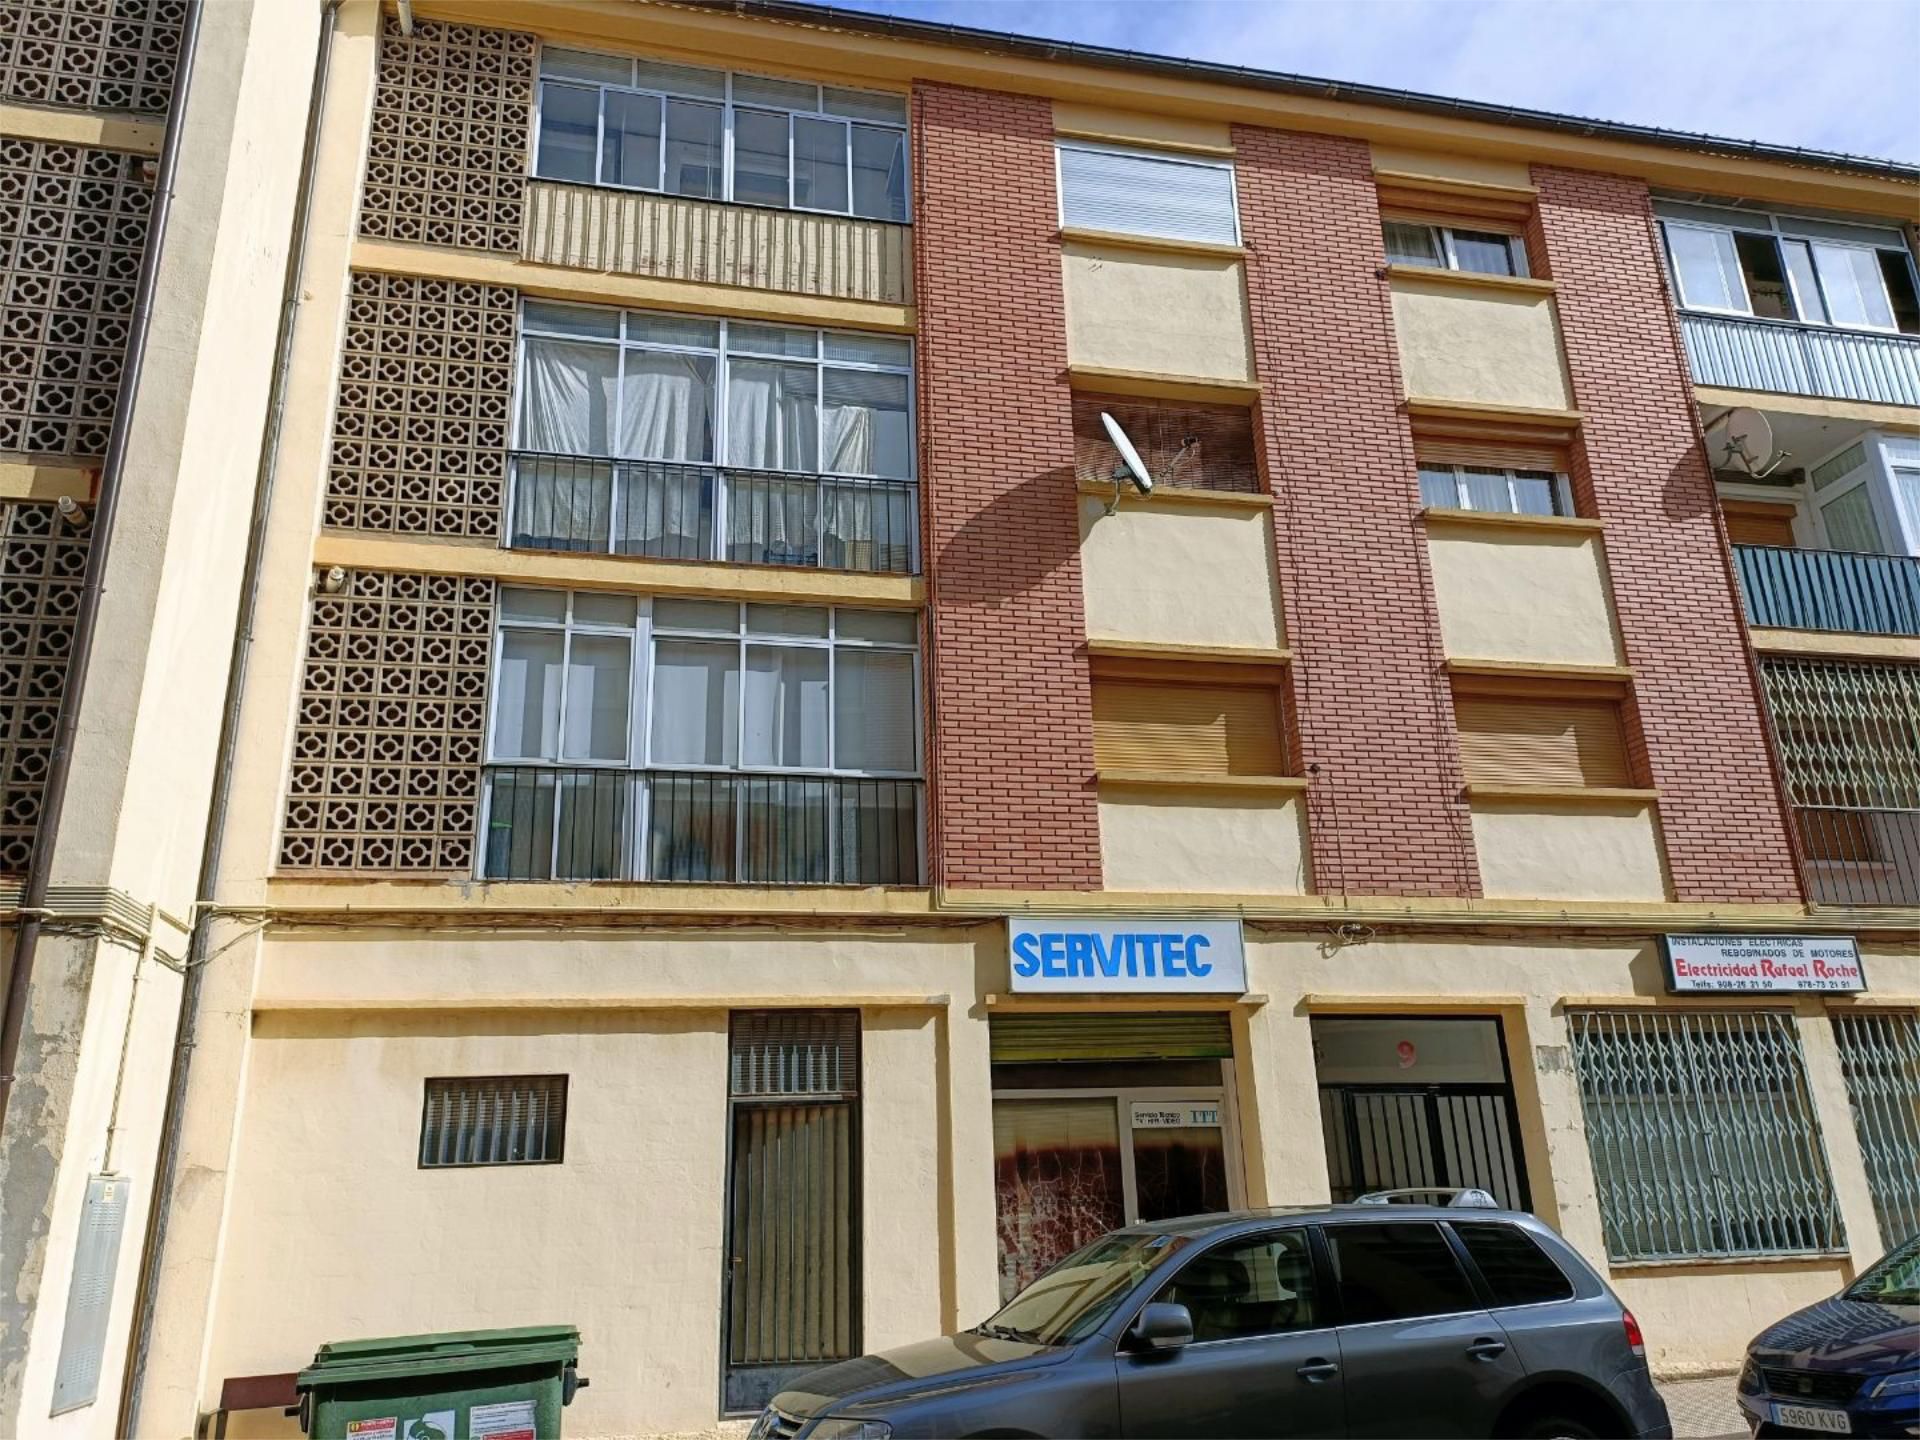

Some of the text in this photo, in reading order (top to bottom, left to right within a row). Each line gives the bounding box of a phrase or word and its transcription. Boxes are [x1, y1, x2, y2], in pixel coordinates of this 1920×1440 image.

[1672, 937, 1803, 947] INSTALACIONES ELECTRICAS
[1721, 948, 1854, 958] REBOBINADOS DE MOTORES
[1012, 932, 1213, 978] SERVITEC
[1675, 958, 1858, 979] Electricidad Rafael Roche
[1396, 1040, 1417, 1069] 9
[1780, 1407, 1847, 1430] 5960 KVG
